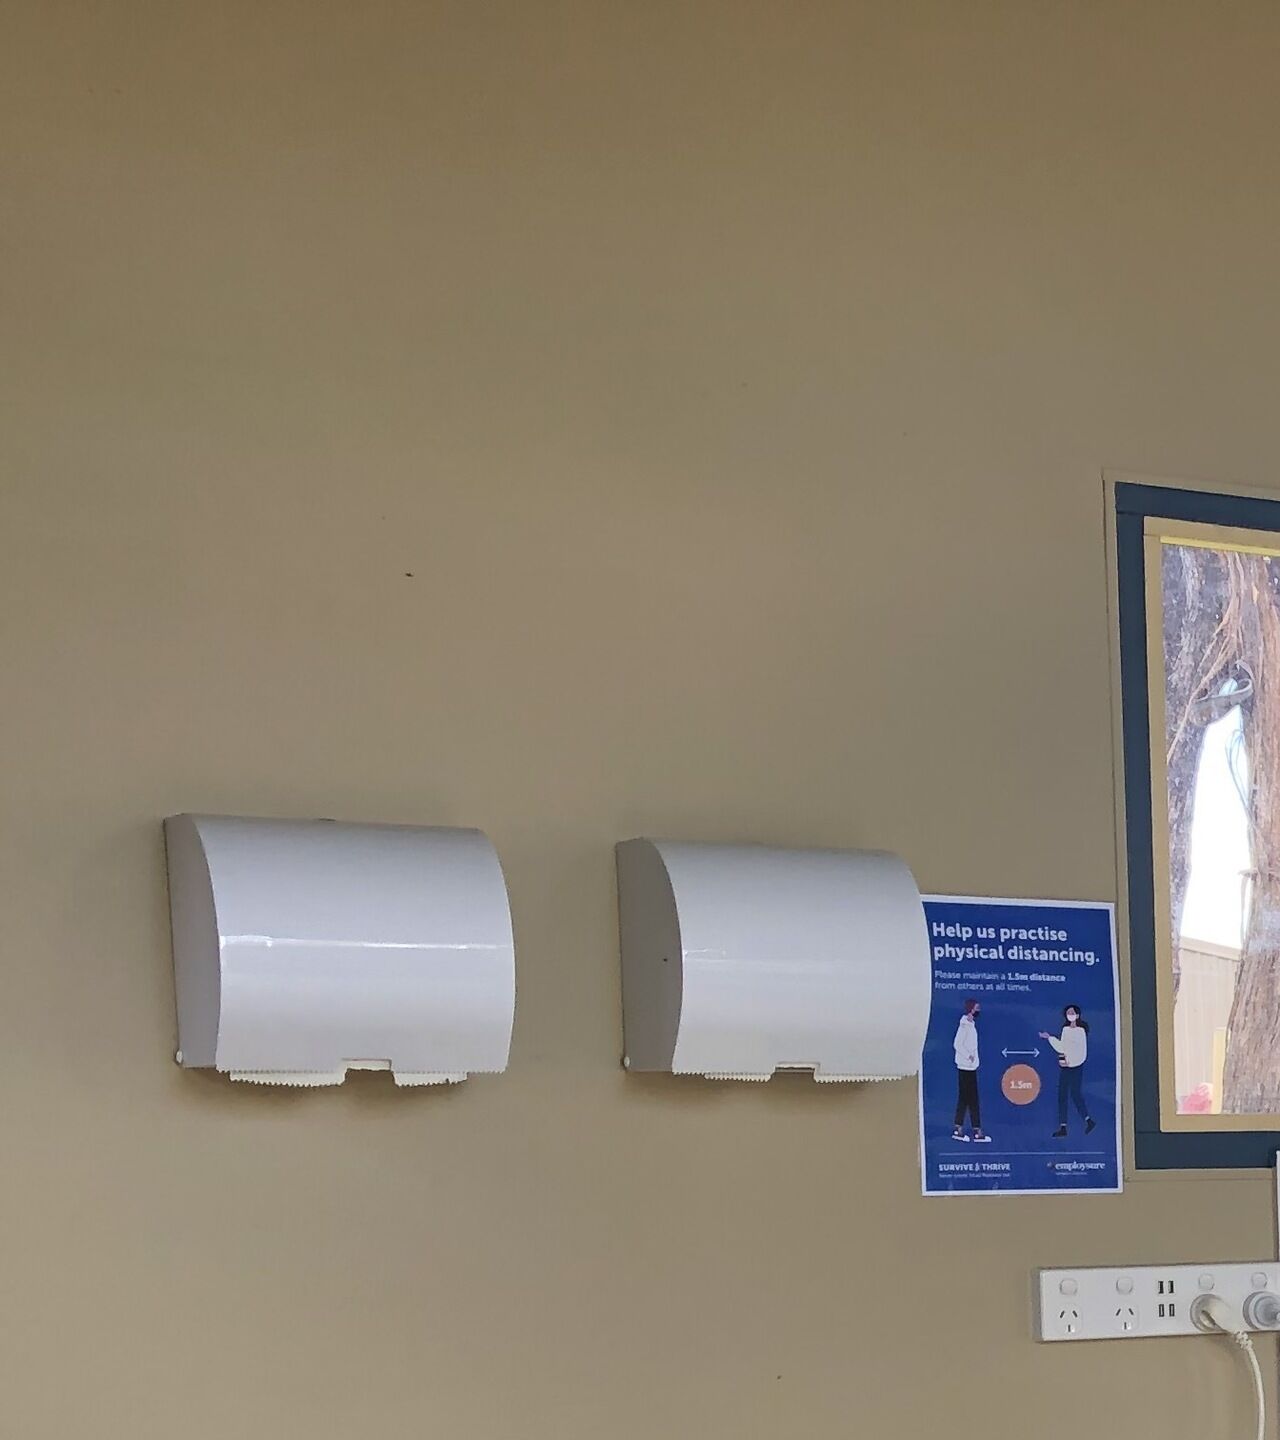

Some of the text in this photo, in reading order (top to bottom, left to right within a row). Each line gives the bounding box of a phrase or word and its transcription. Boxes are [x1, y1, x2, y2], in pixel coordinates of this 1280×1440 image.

[932, 922, 1068, 942] Help us practise
[934, 943, 1100, 966] physical distancing.
[934, 970, 961, 979] Please
[963, 971, 999, 980] maintain
[1007, 972, 1029, 981] 1.5m
[1029, 973, 1066, 982] distance
[934, 981, 1032, 992] from others at all times.
[1009, 1080, 1032, 1089] 1.5m
[938, 1162, 973, 1171] SURVIVE
[982, 1163, 1011, 1171] THRIVE
[1054, 1160, 1106, 1172] employsure
